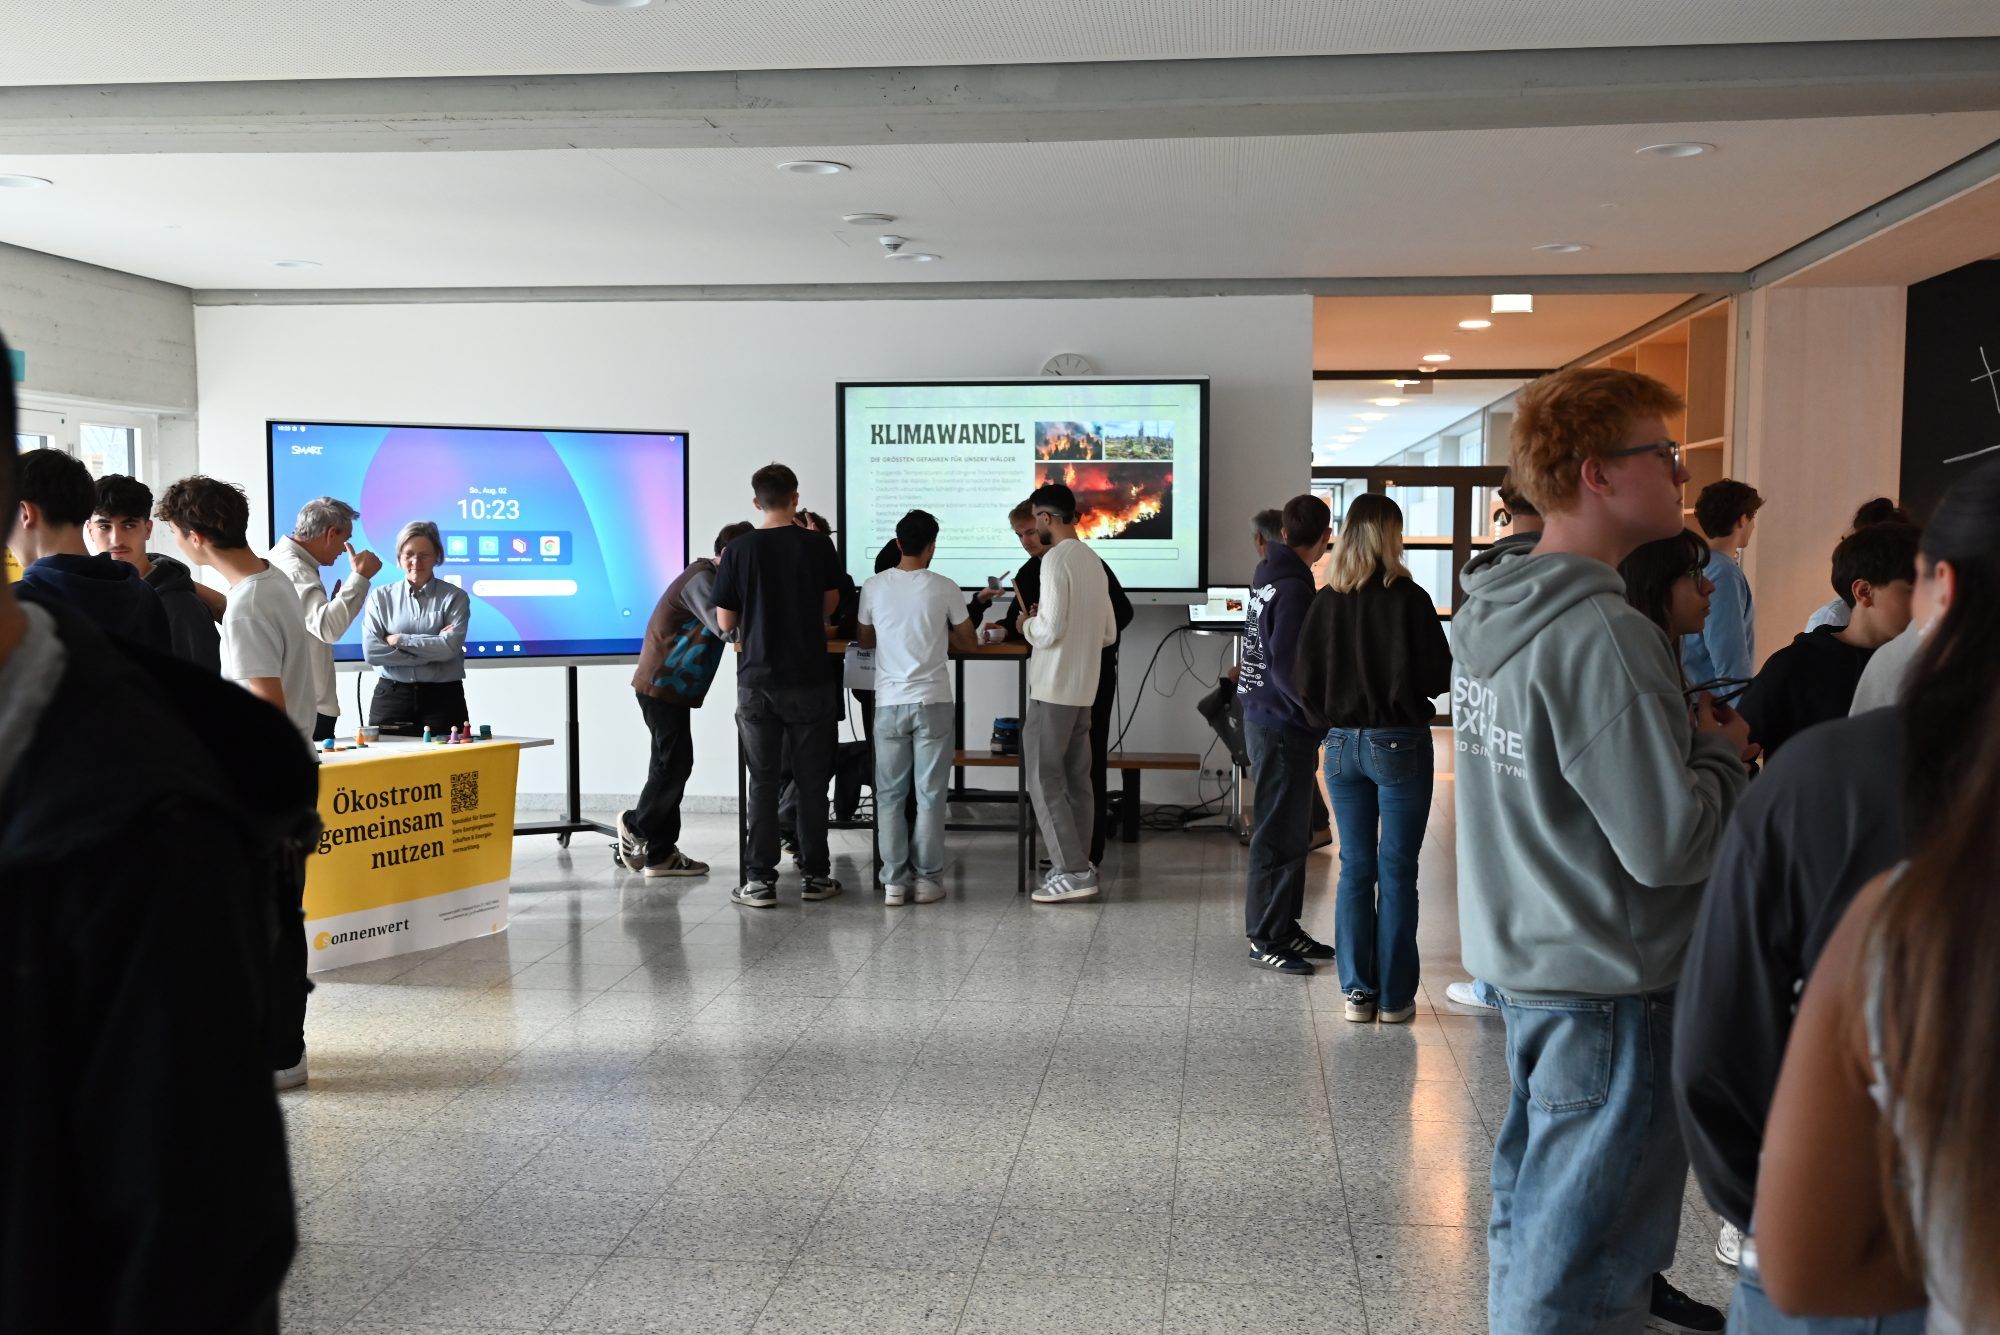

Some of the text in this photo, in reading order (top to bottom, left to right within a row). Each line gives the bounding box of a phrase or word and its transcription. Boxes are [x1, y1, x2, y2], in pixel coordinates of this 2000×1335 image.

[871, 423, 1025, 445] KLIMAWANDEL
[291, 445, 324, 455] SMART
[498, 487, 507, 495] 02
[457, 498, 520, 520] 10:23
[333, 782, 443, 815] Ökostrom
[318, 811, 444, 855] gemeinsam
[371, 839, 445, 870] nutzen
